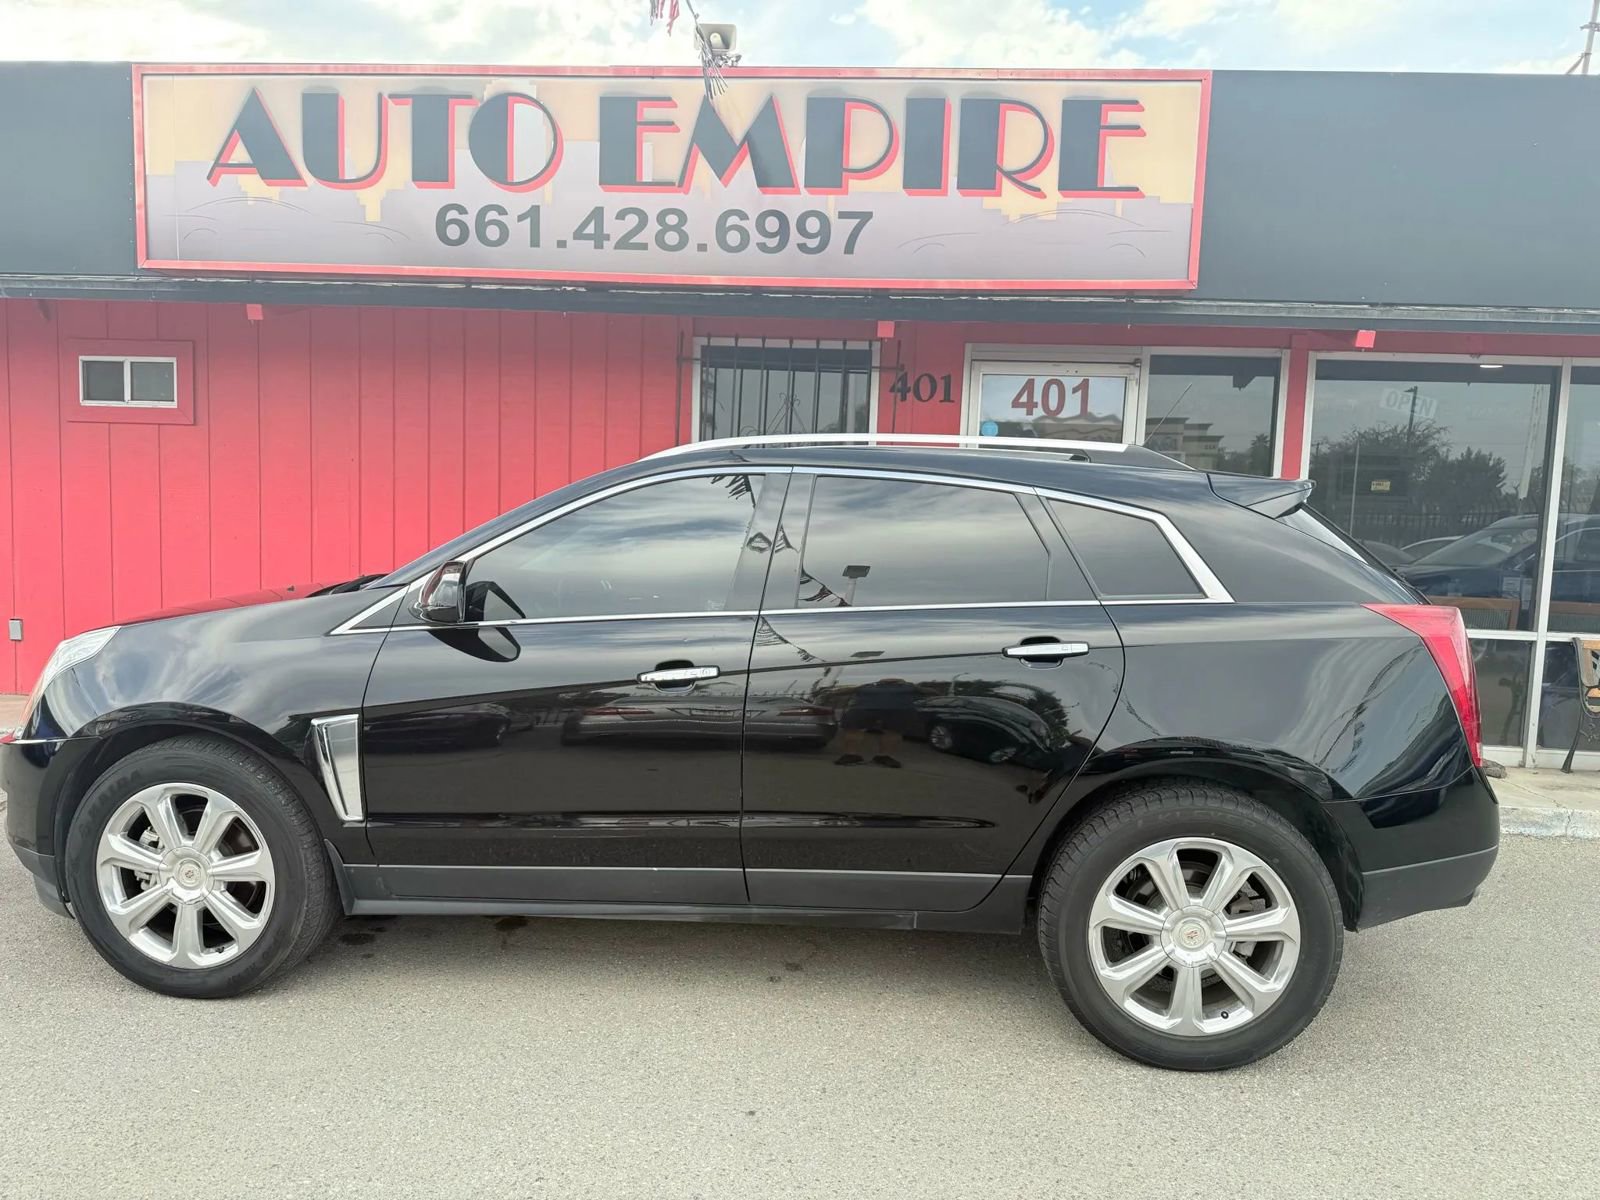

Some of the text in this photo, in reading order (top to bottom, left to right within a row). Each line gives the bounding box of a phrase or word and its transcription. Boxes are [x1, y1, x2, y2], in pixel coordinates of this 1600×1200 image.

[206, 87, 1147, 199] AUTO EMPIRE
[435, 203, 874, 255] 661.428.6997
[890, 371, 955, 403] 401
[1011, 378, 1090, 417] 401
